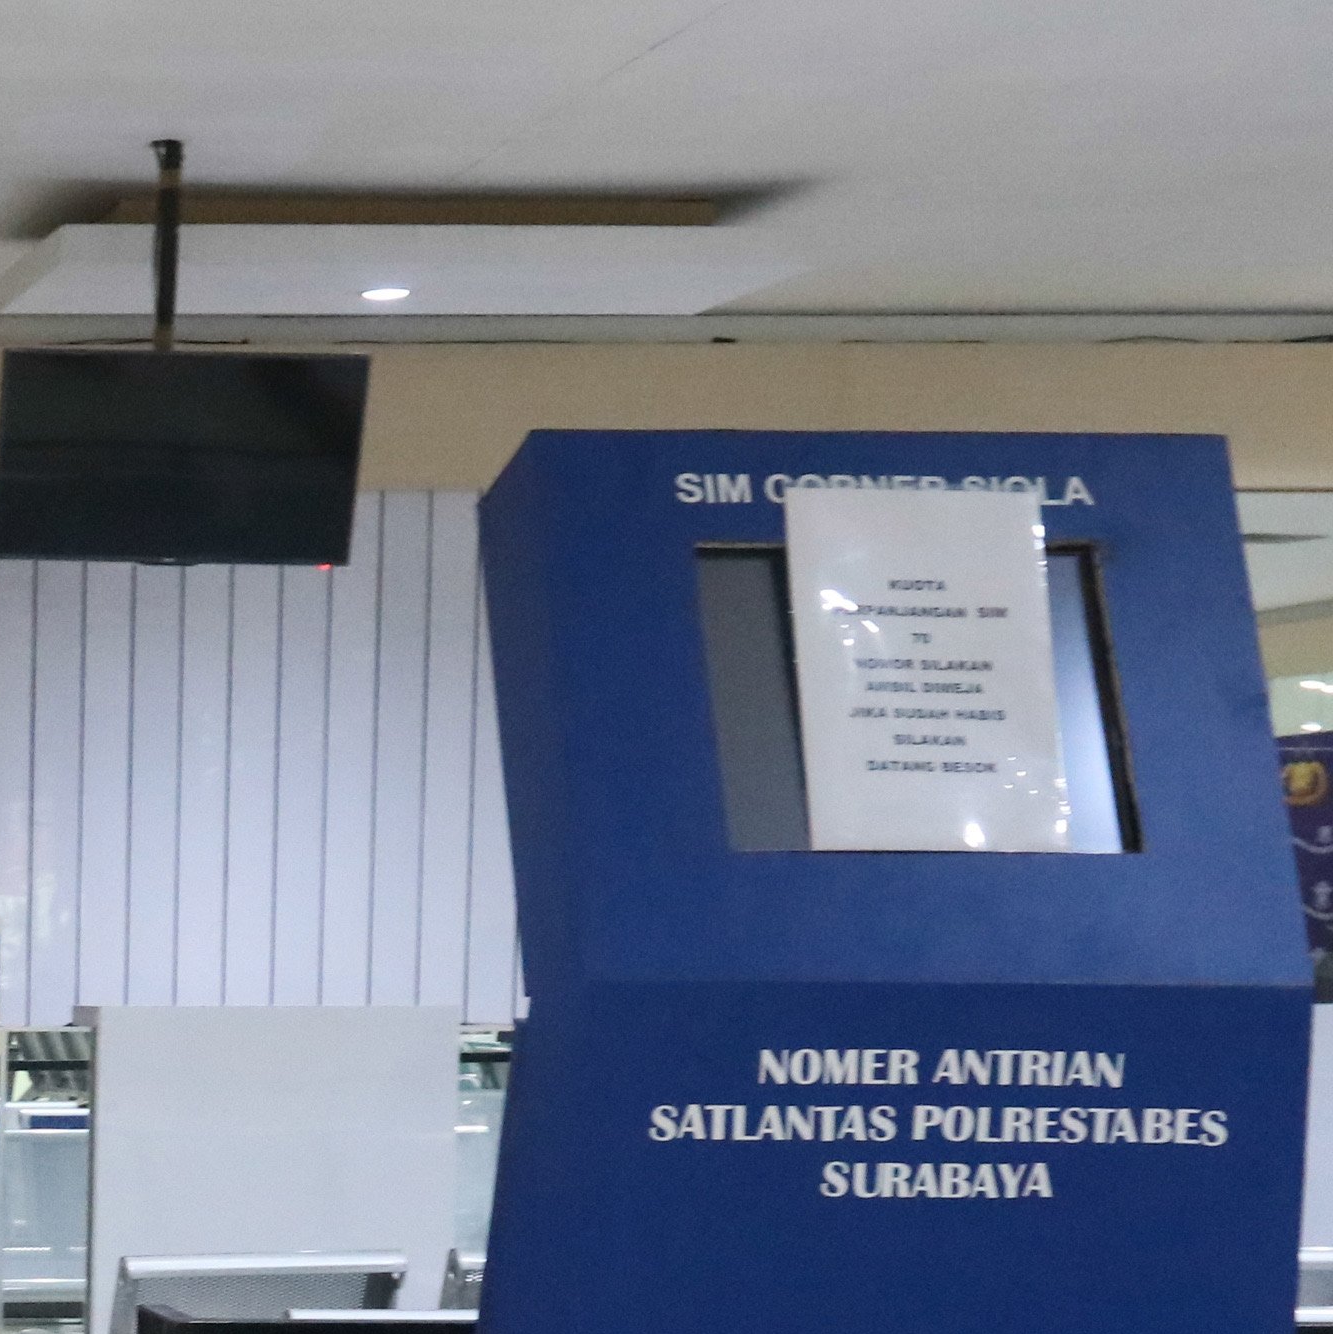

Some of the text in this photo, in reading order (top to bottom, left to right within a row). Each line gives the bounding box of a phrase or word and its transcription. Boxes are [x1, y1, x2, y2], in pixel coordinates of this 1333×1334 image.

[674, 472, 754, 504] SIM
[832, 604, 1009, 618] RPANJANGAN SIM
[757, 1048, 1126, 1089] NOMER ANTRIAN
[647, 1104, 1230, 1148] SATLANTAS POLRESTABES
[818, 1160, 1053, 1199] SURABAYA
